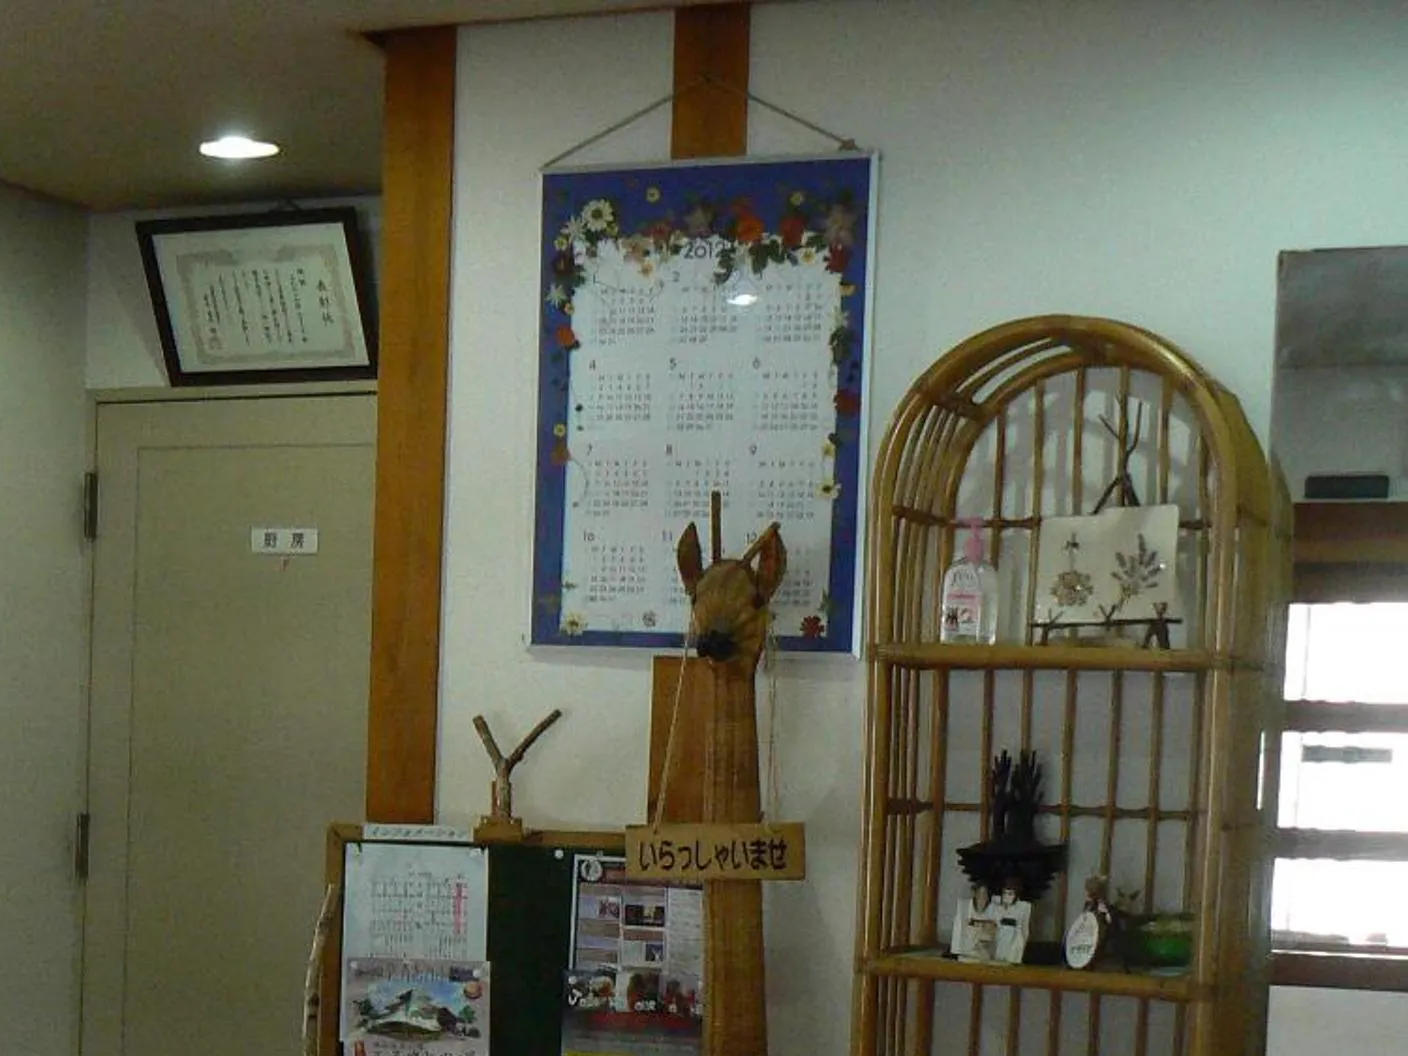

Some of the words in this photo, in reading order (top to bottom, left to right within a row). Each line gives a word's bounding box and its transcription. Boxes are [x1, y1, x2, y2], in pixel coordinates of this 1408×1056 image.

[638, 838, 789, 872] いらっしゃいませ
